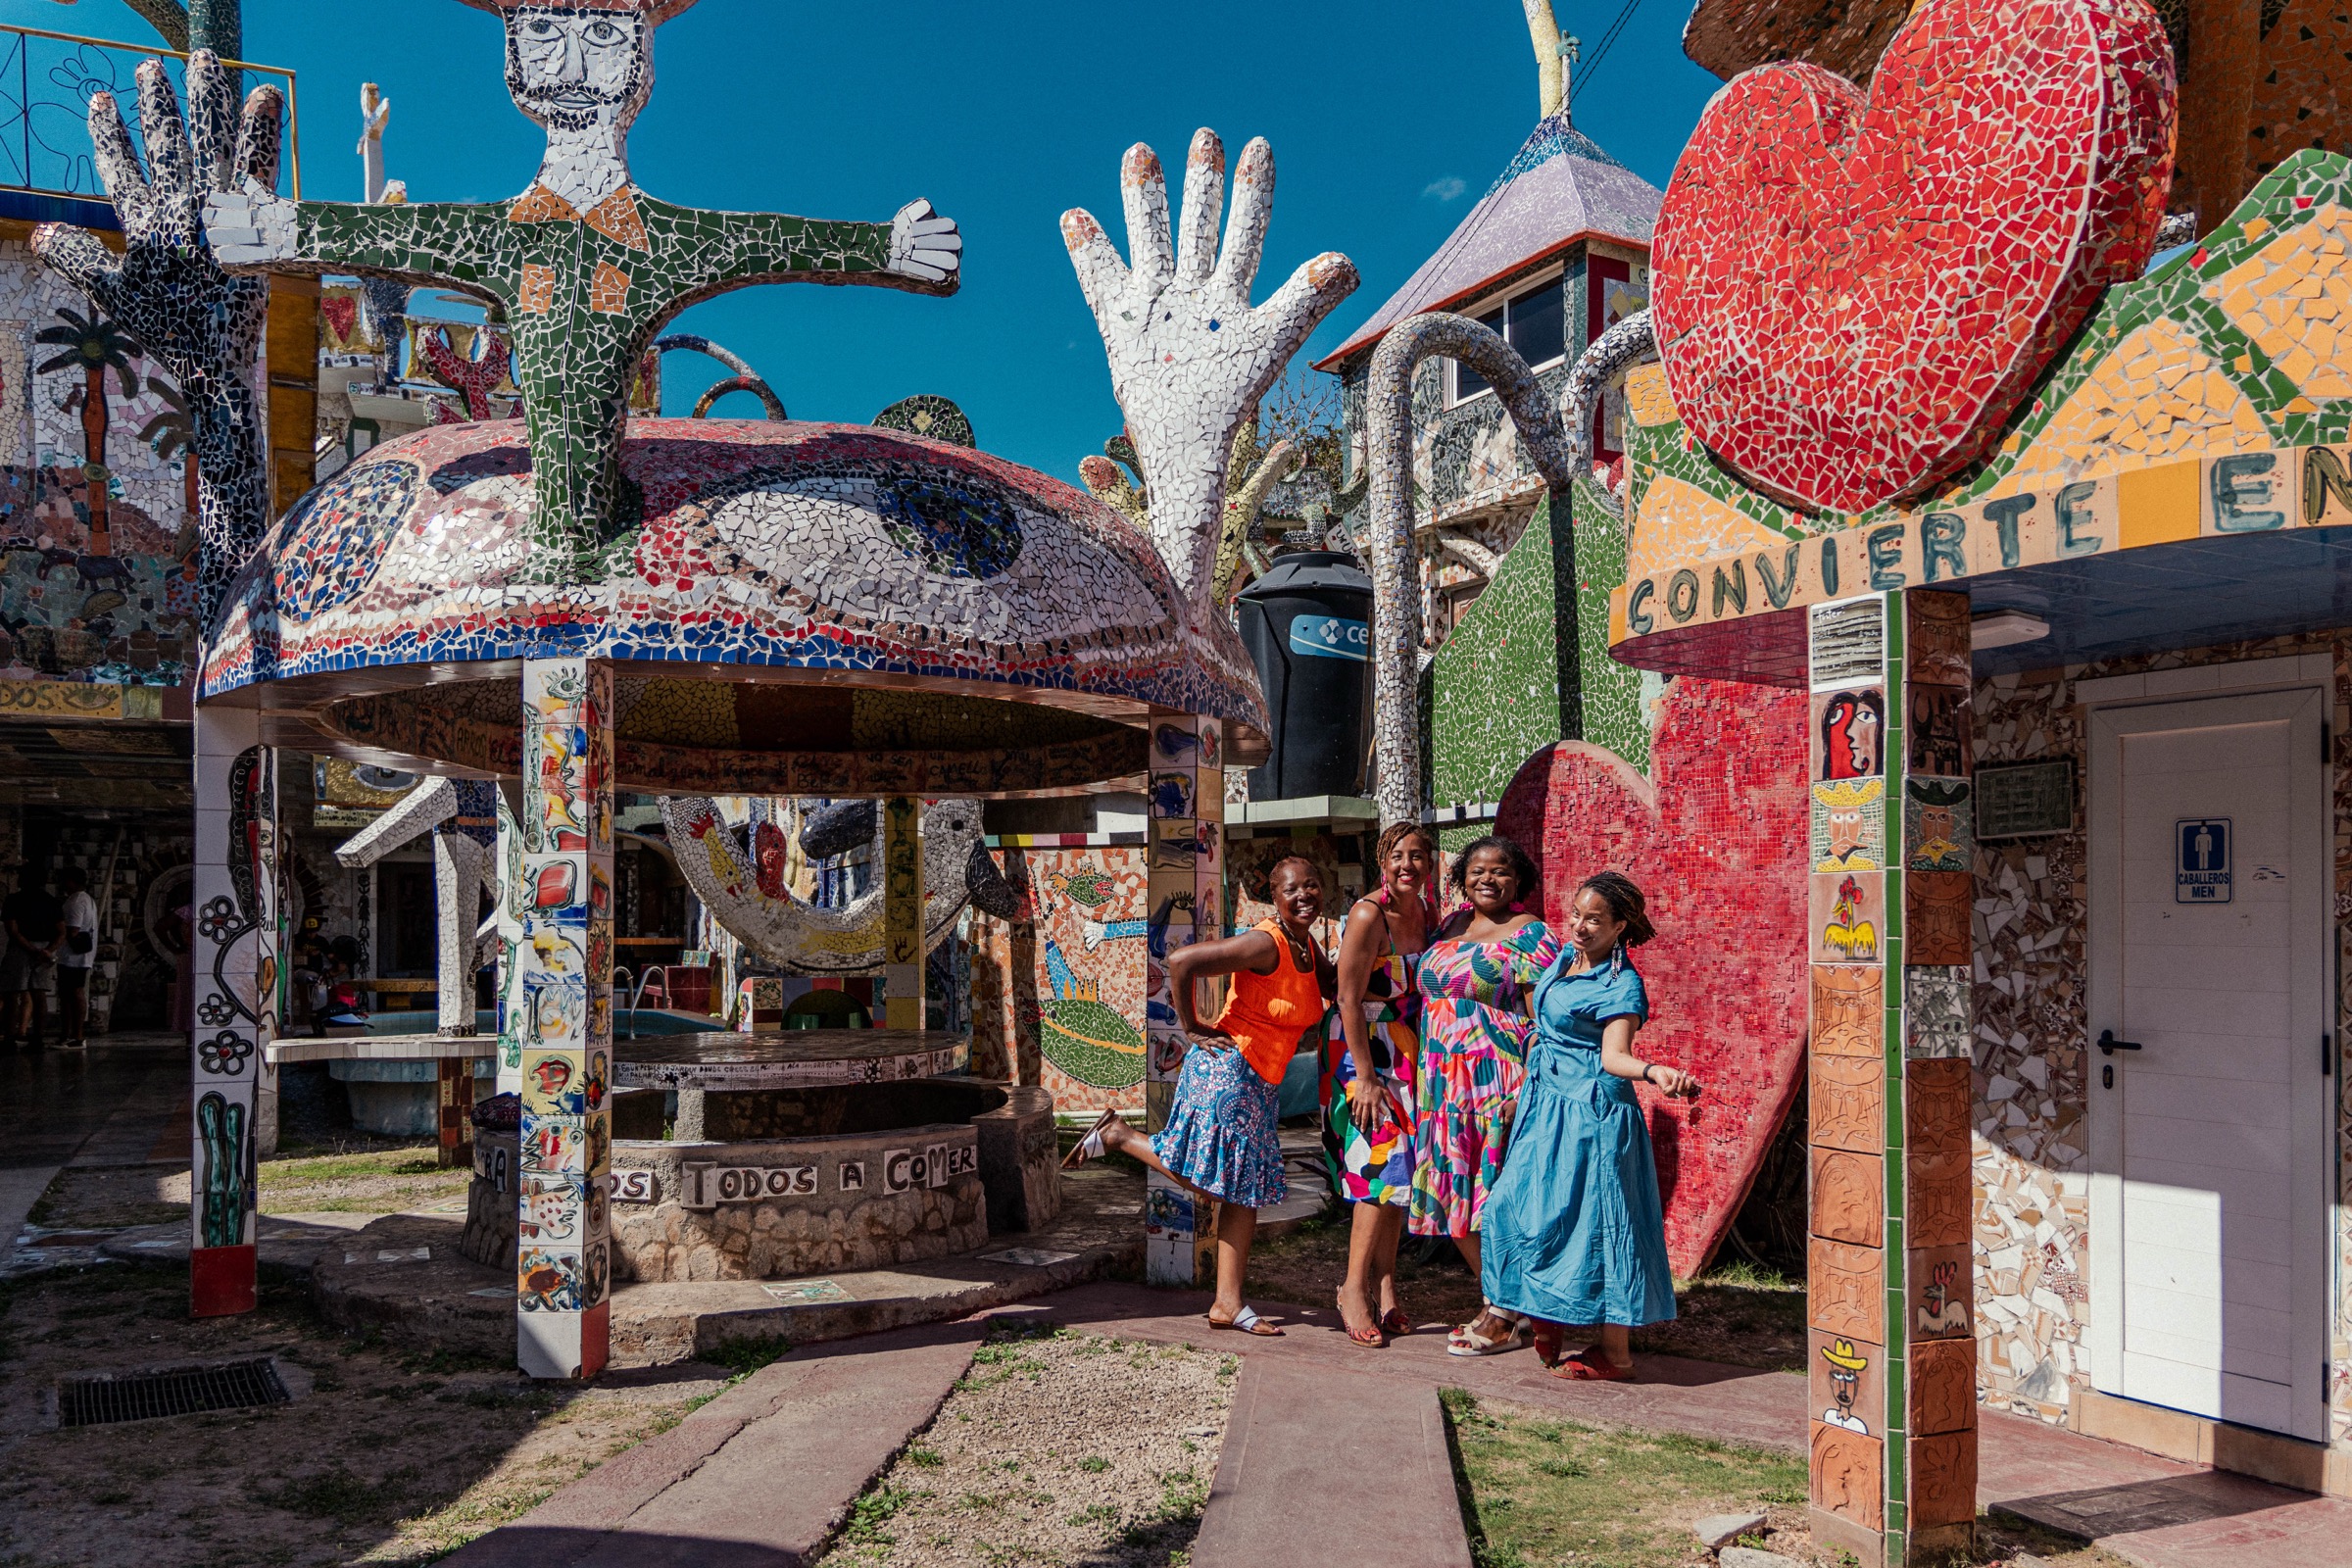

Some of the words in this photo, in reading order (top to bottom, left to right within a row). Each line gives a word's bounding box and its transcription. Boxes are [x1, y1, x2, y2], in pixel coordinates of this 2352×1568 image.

[1629, 480, 2104, 635] CONVIERTE
[2209, 445, 2352, 533] EN
[2178, 872, 2230, 885] CABALLEROS
[2191, 886, 2216, 899] MEN
[685, 1162, 815, 1206] TODOS
[843, 1163, 862, 1189] A
[887, 1147, 976, 1193] COMER
